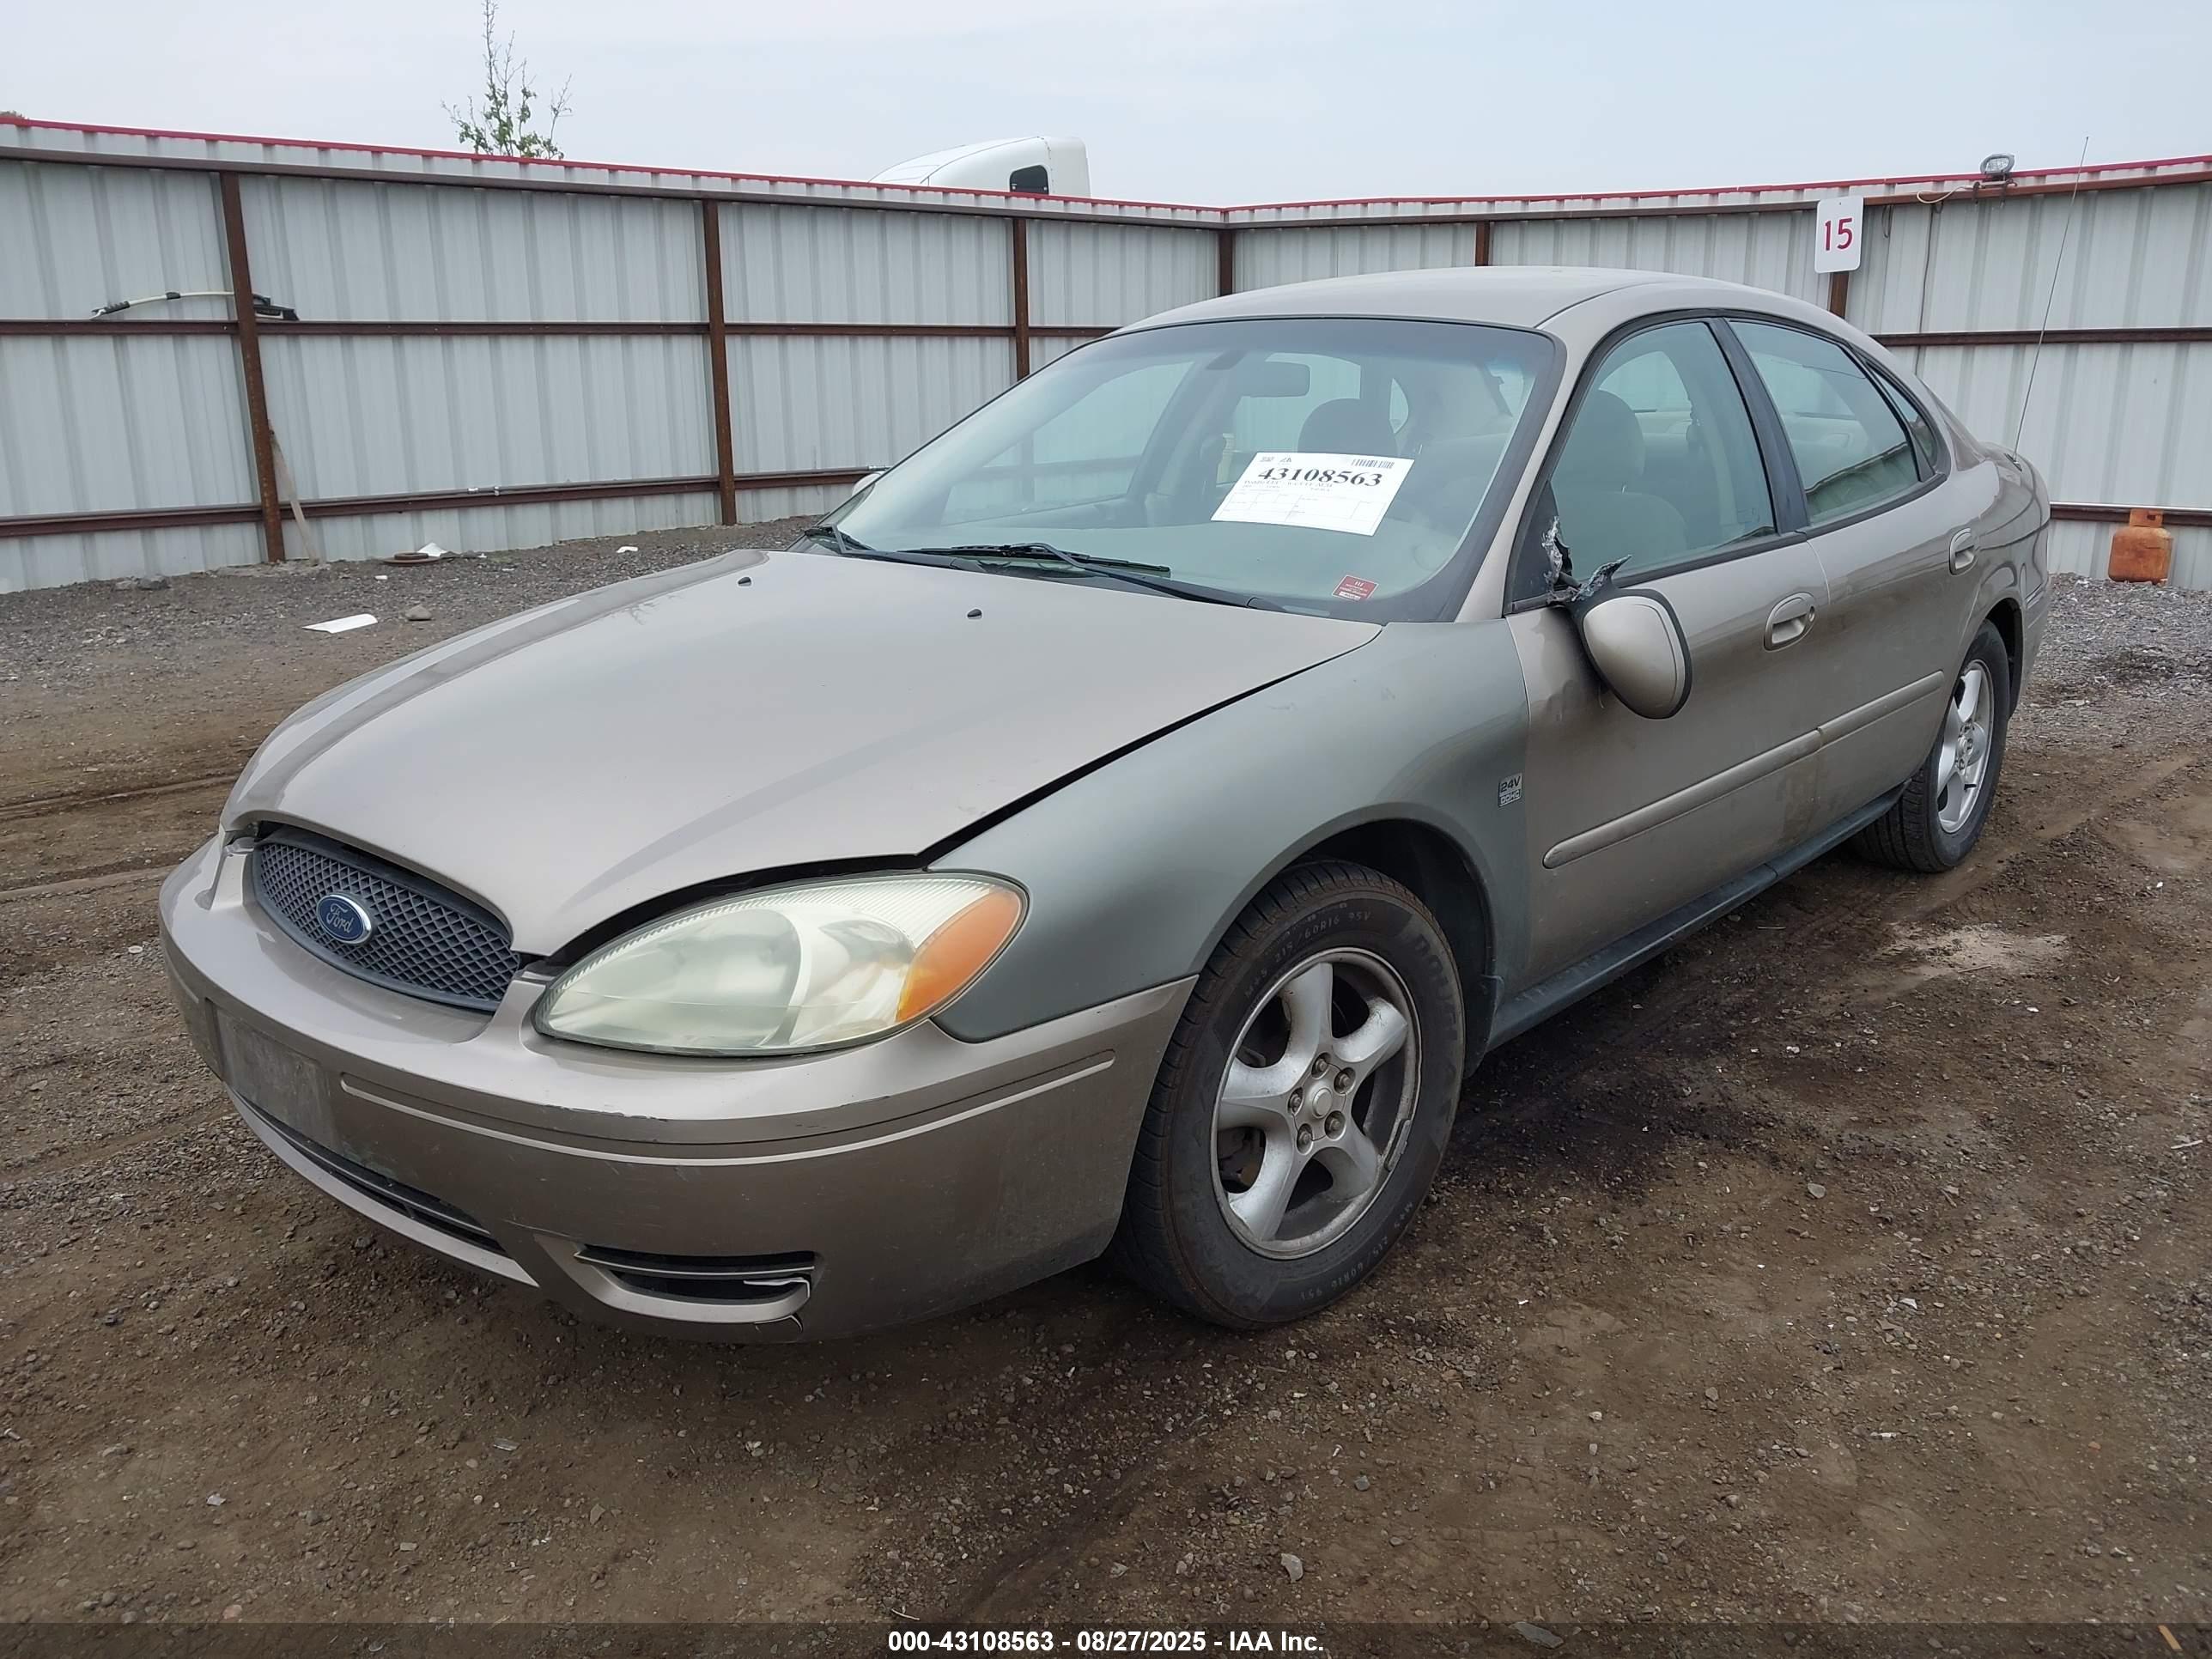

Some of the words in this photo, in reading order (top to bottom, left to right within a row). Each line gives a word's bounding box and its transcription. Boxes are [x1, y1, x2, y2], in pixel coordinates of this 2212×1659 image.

[1825, 217, 1853, 251] 15
[1258, 467, 1383, 487] 43108563
[1500, 776, 1521, 793] 24V
[1500, 789, 1521, 805] DOHC
[326, 903, 354, 933] Ford
